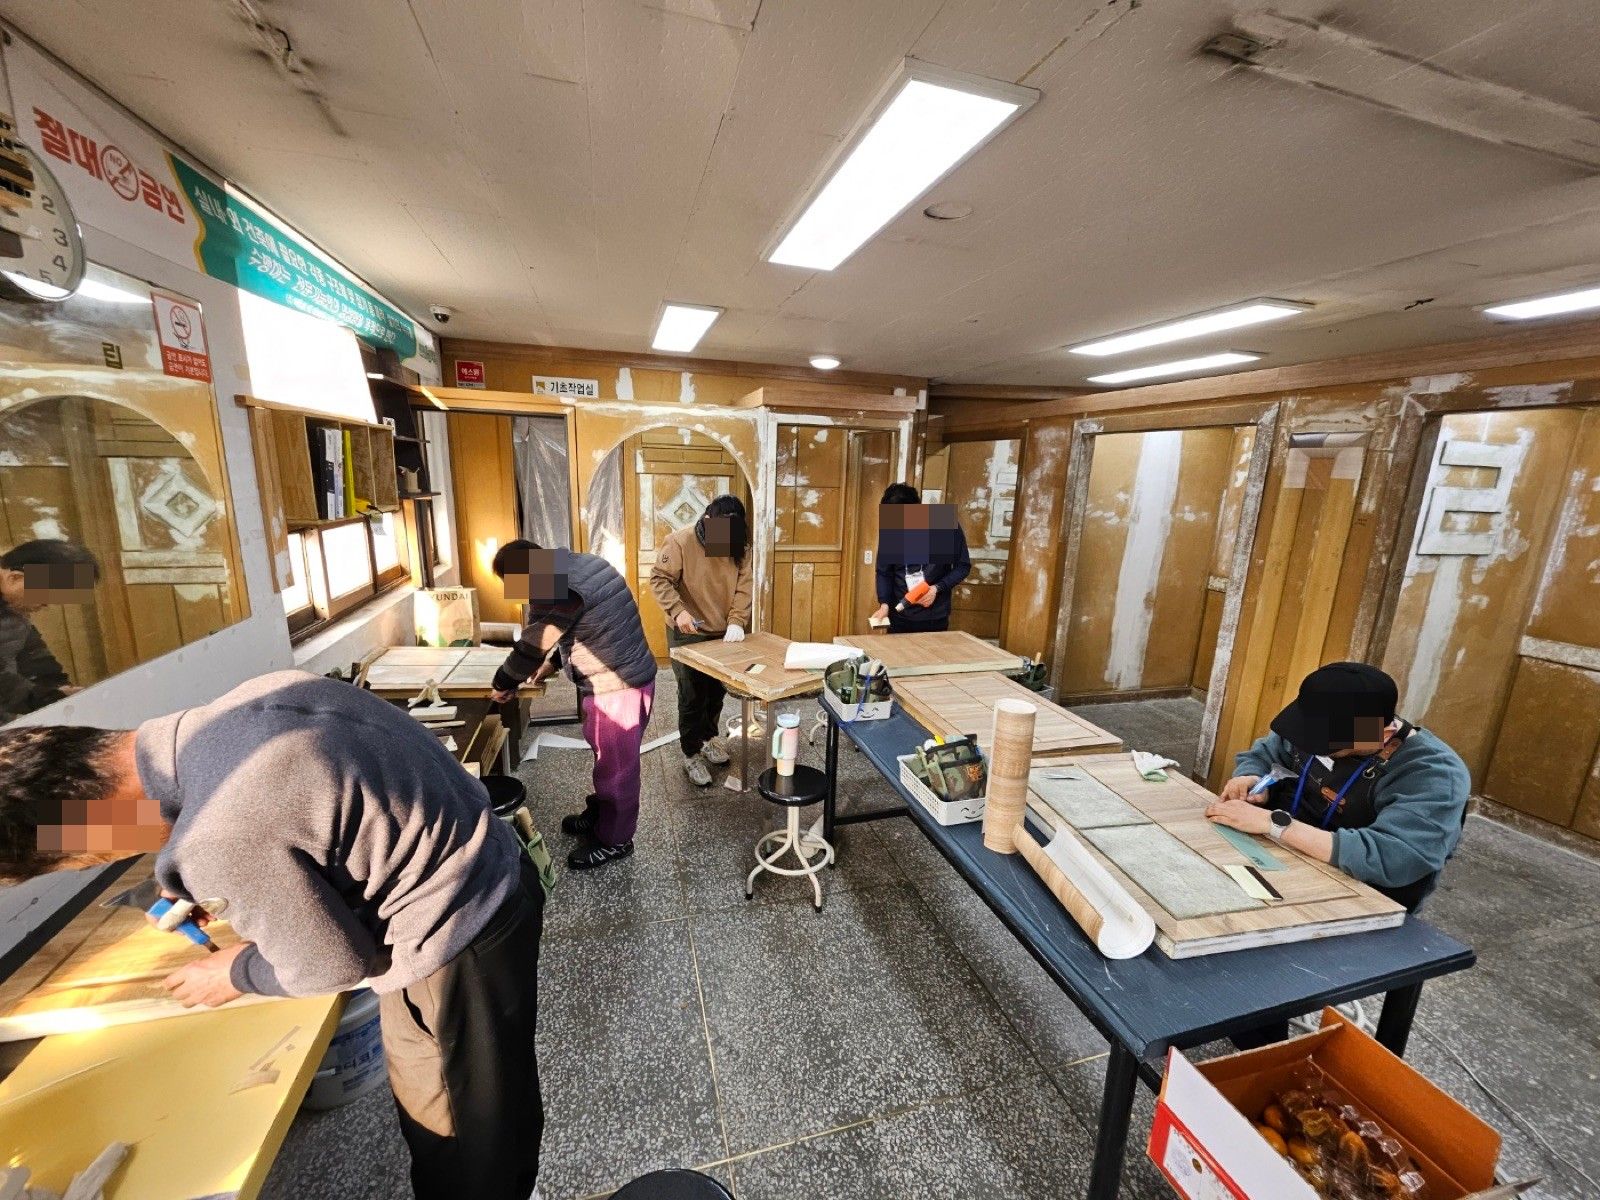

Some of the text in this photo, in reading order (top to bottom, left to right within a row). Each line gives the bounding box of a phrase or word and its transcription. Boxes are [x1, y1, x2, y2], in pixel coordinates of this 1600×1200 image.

[33, 106, 185, 224] 절대 금연
[41, 194, 56, 215] 2
[53, 227, 68, 248] 3
[52, 255, 67, 272] 4
[550, 381, 594, 395] 기초작업실
